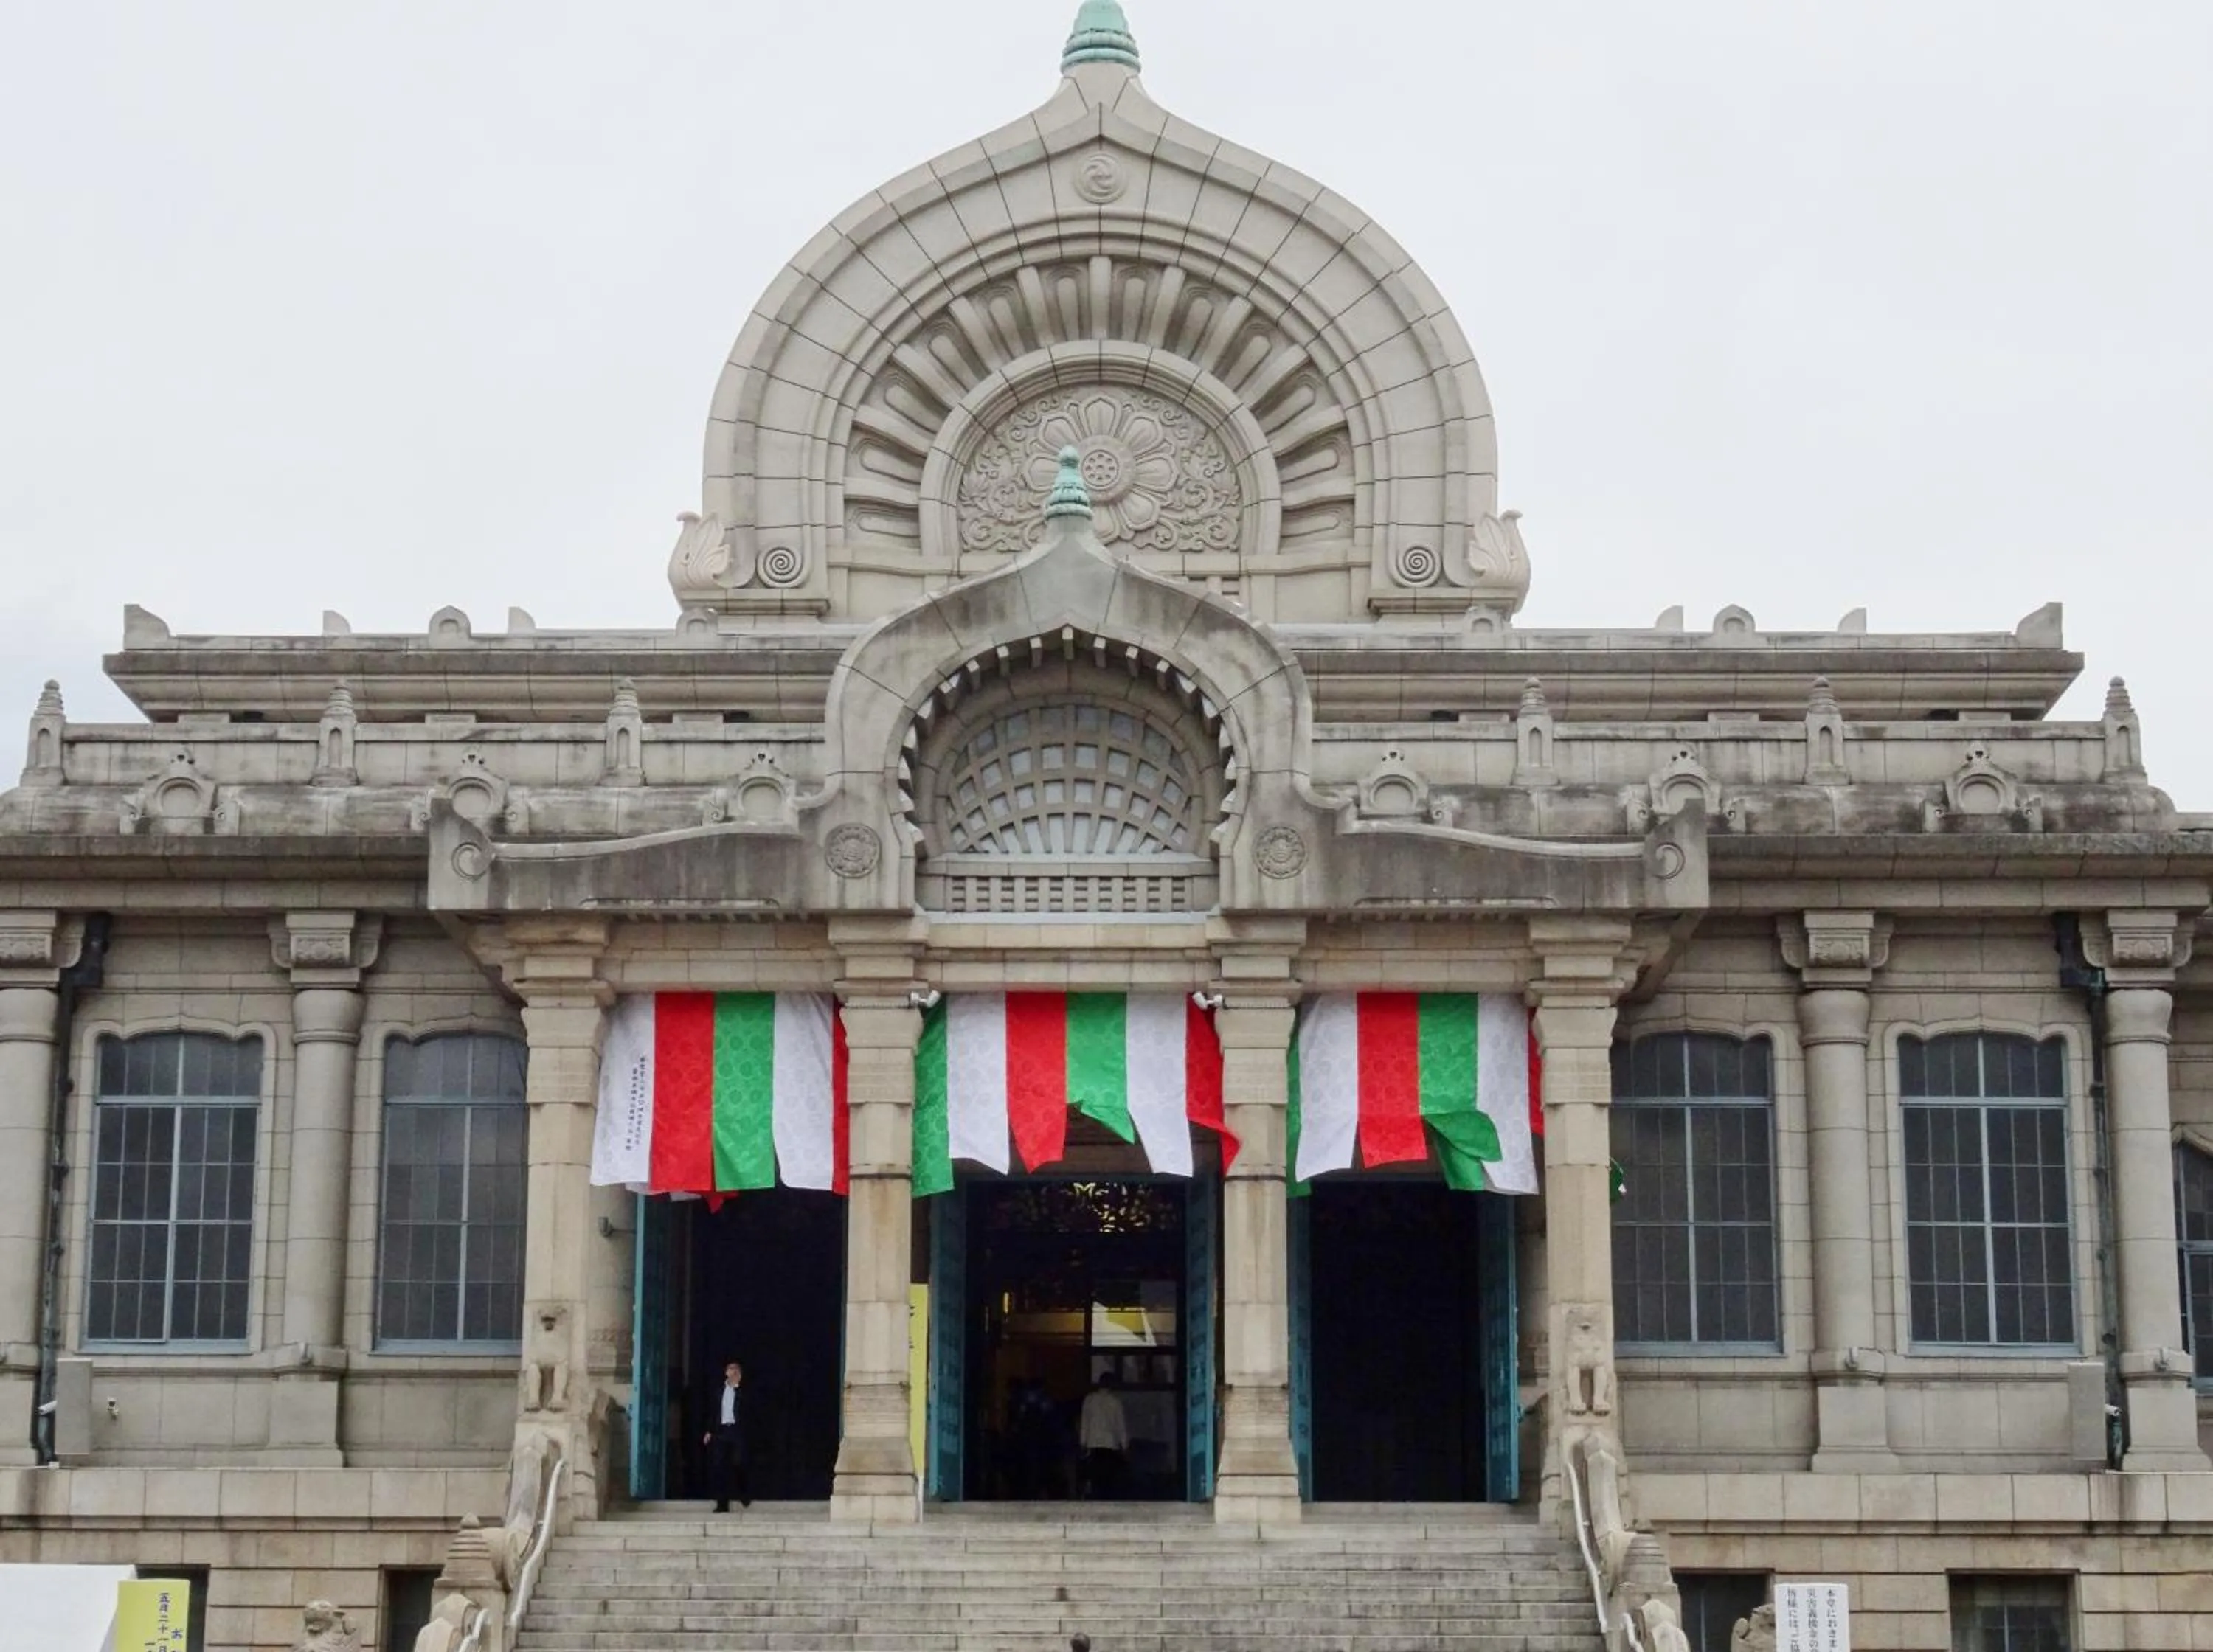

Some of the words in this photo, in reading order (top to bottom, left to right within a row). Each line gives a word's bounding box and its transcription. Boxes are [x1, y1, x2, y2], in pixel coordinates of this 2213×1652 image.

[170, 1628, 184, 1652] お
[1806, 1588, 1818, 1652] 災害義援金の
[1827, 1589, 1838, 1652] 本堂におきま
